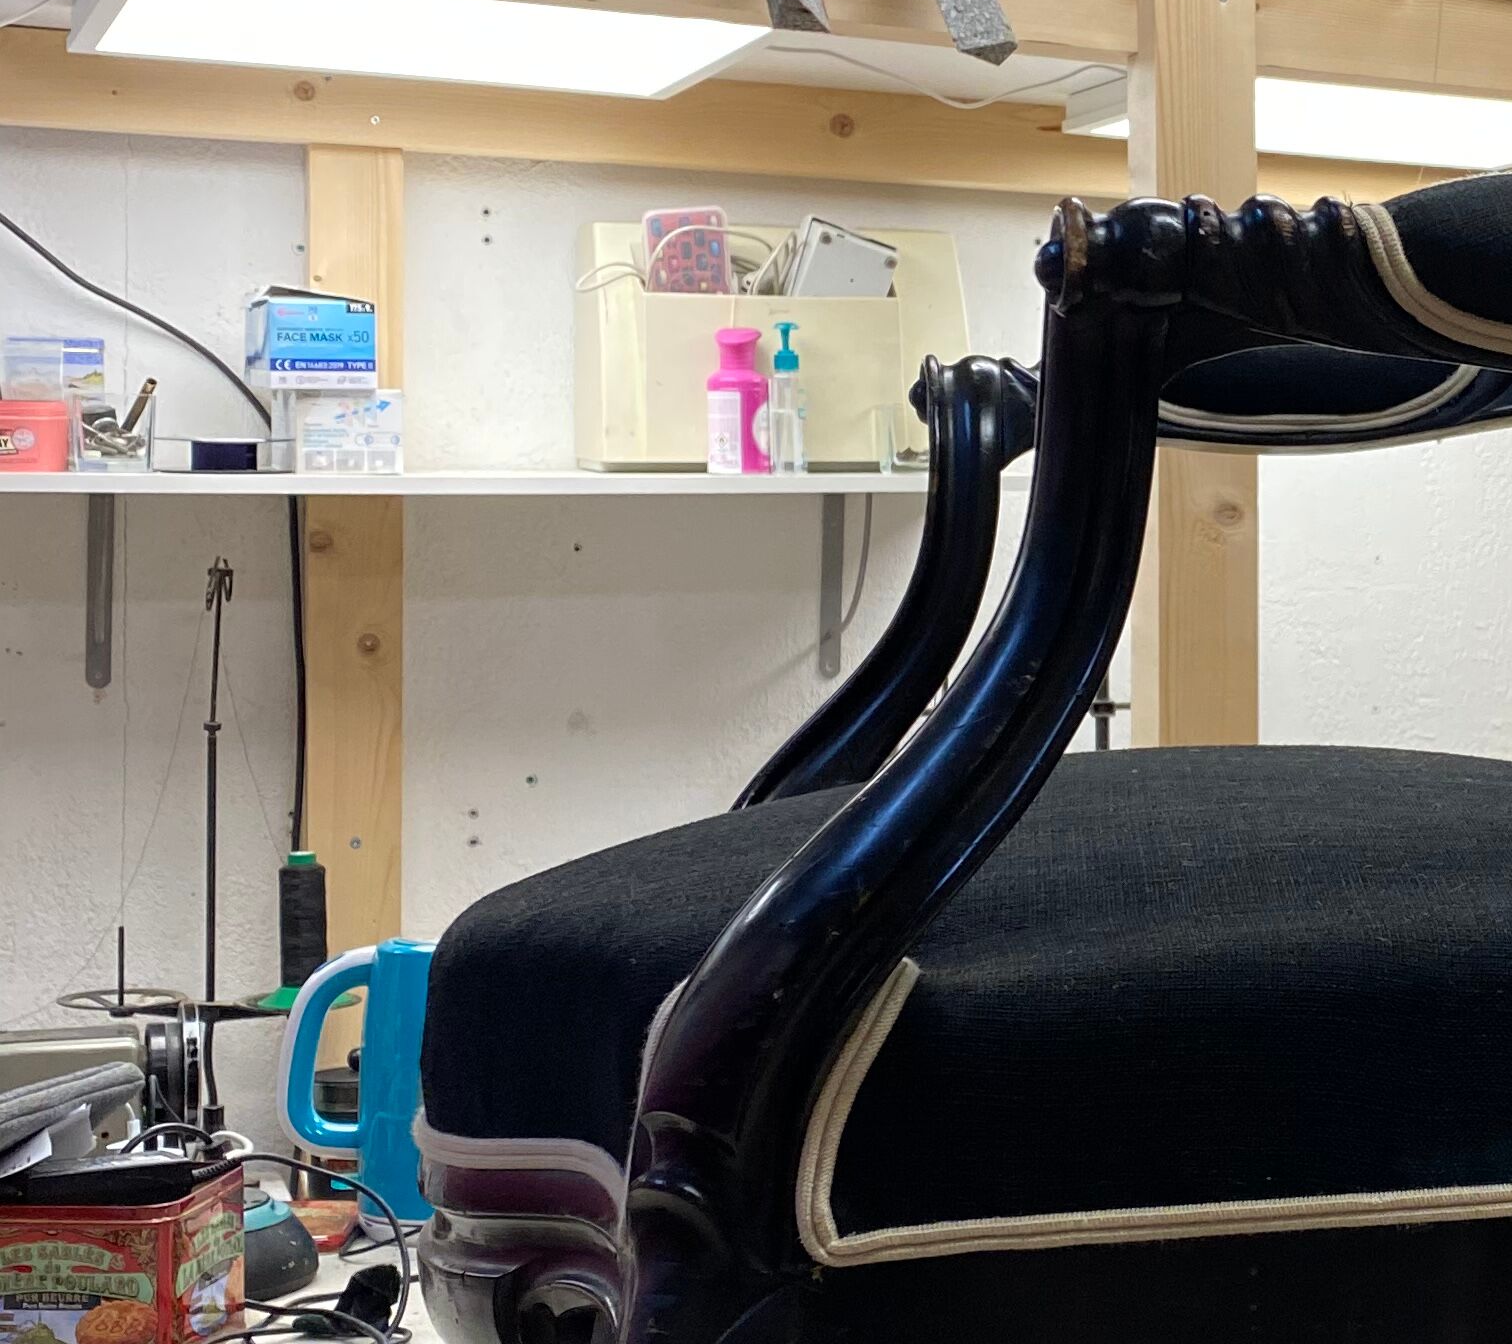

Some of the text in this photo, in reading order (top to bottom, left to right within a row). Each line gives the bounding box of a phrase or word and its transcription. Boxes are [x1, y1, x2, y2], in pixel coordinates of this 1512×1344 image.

[277, 331, 369, 343] FACE MASK x50
